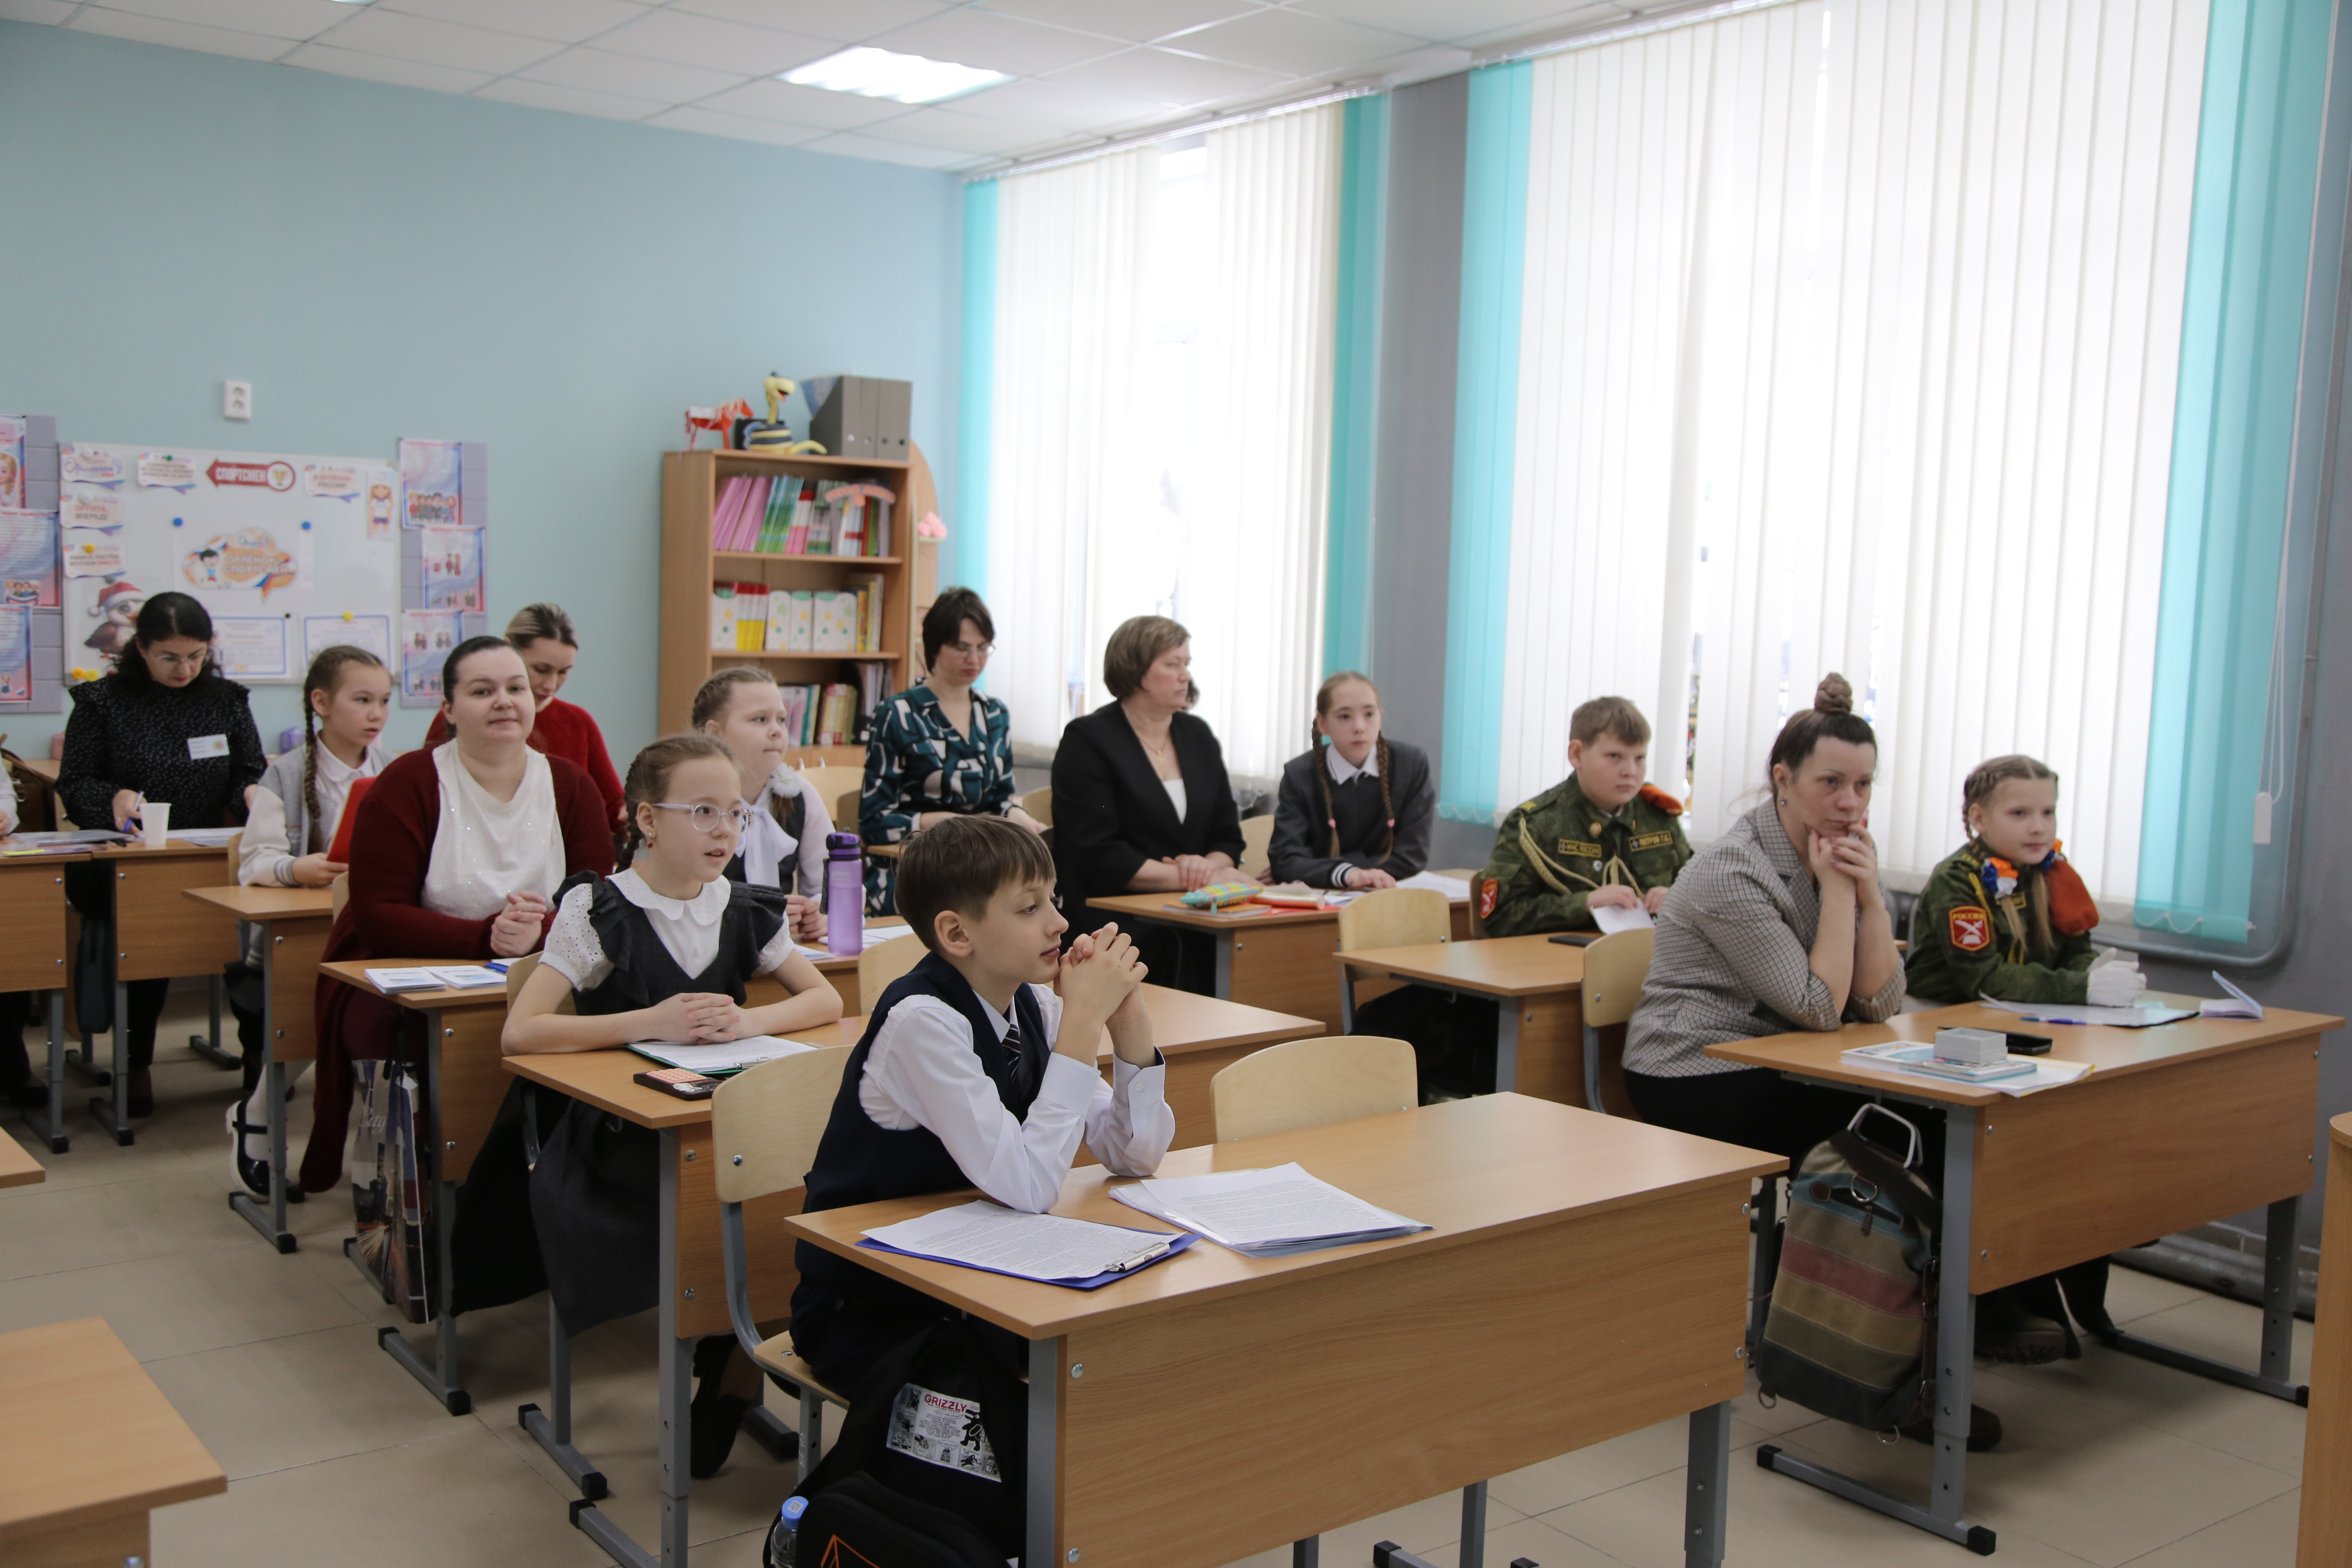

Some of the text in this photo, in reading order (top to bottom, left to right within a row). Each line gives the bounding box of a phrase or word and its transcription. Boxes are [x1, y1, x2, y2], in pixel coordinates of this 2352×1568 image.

[216, 466, 266, 483] СПОРТСМЕН
[227, 554, 276, 564] ОРЛЁНОК
[223, 565, 288, 574] СПОРТСМЕН
[1639, 836, 1660, 846] ПЕТРОВ
[925, 1394, 967, 1412] GRIZZLY
